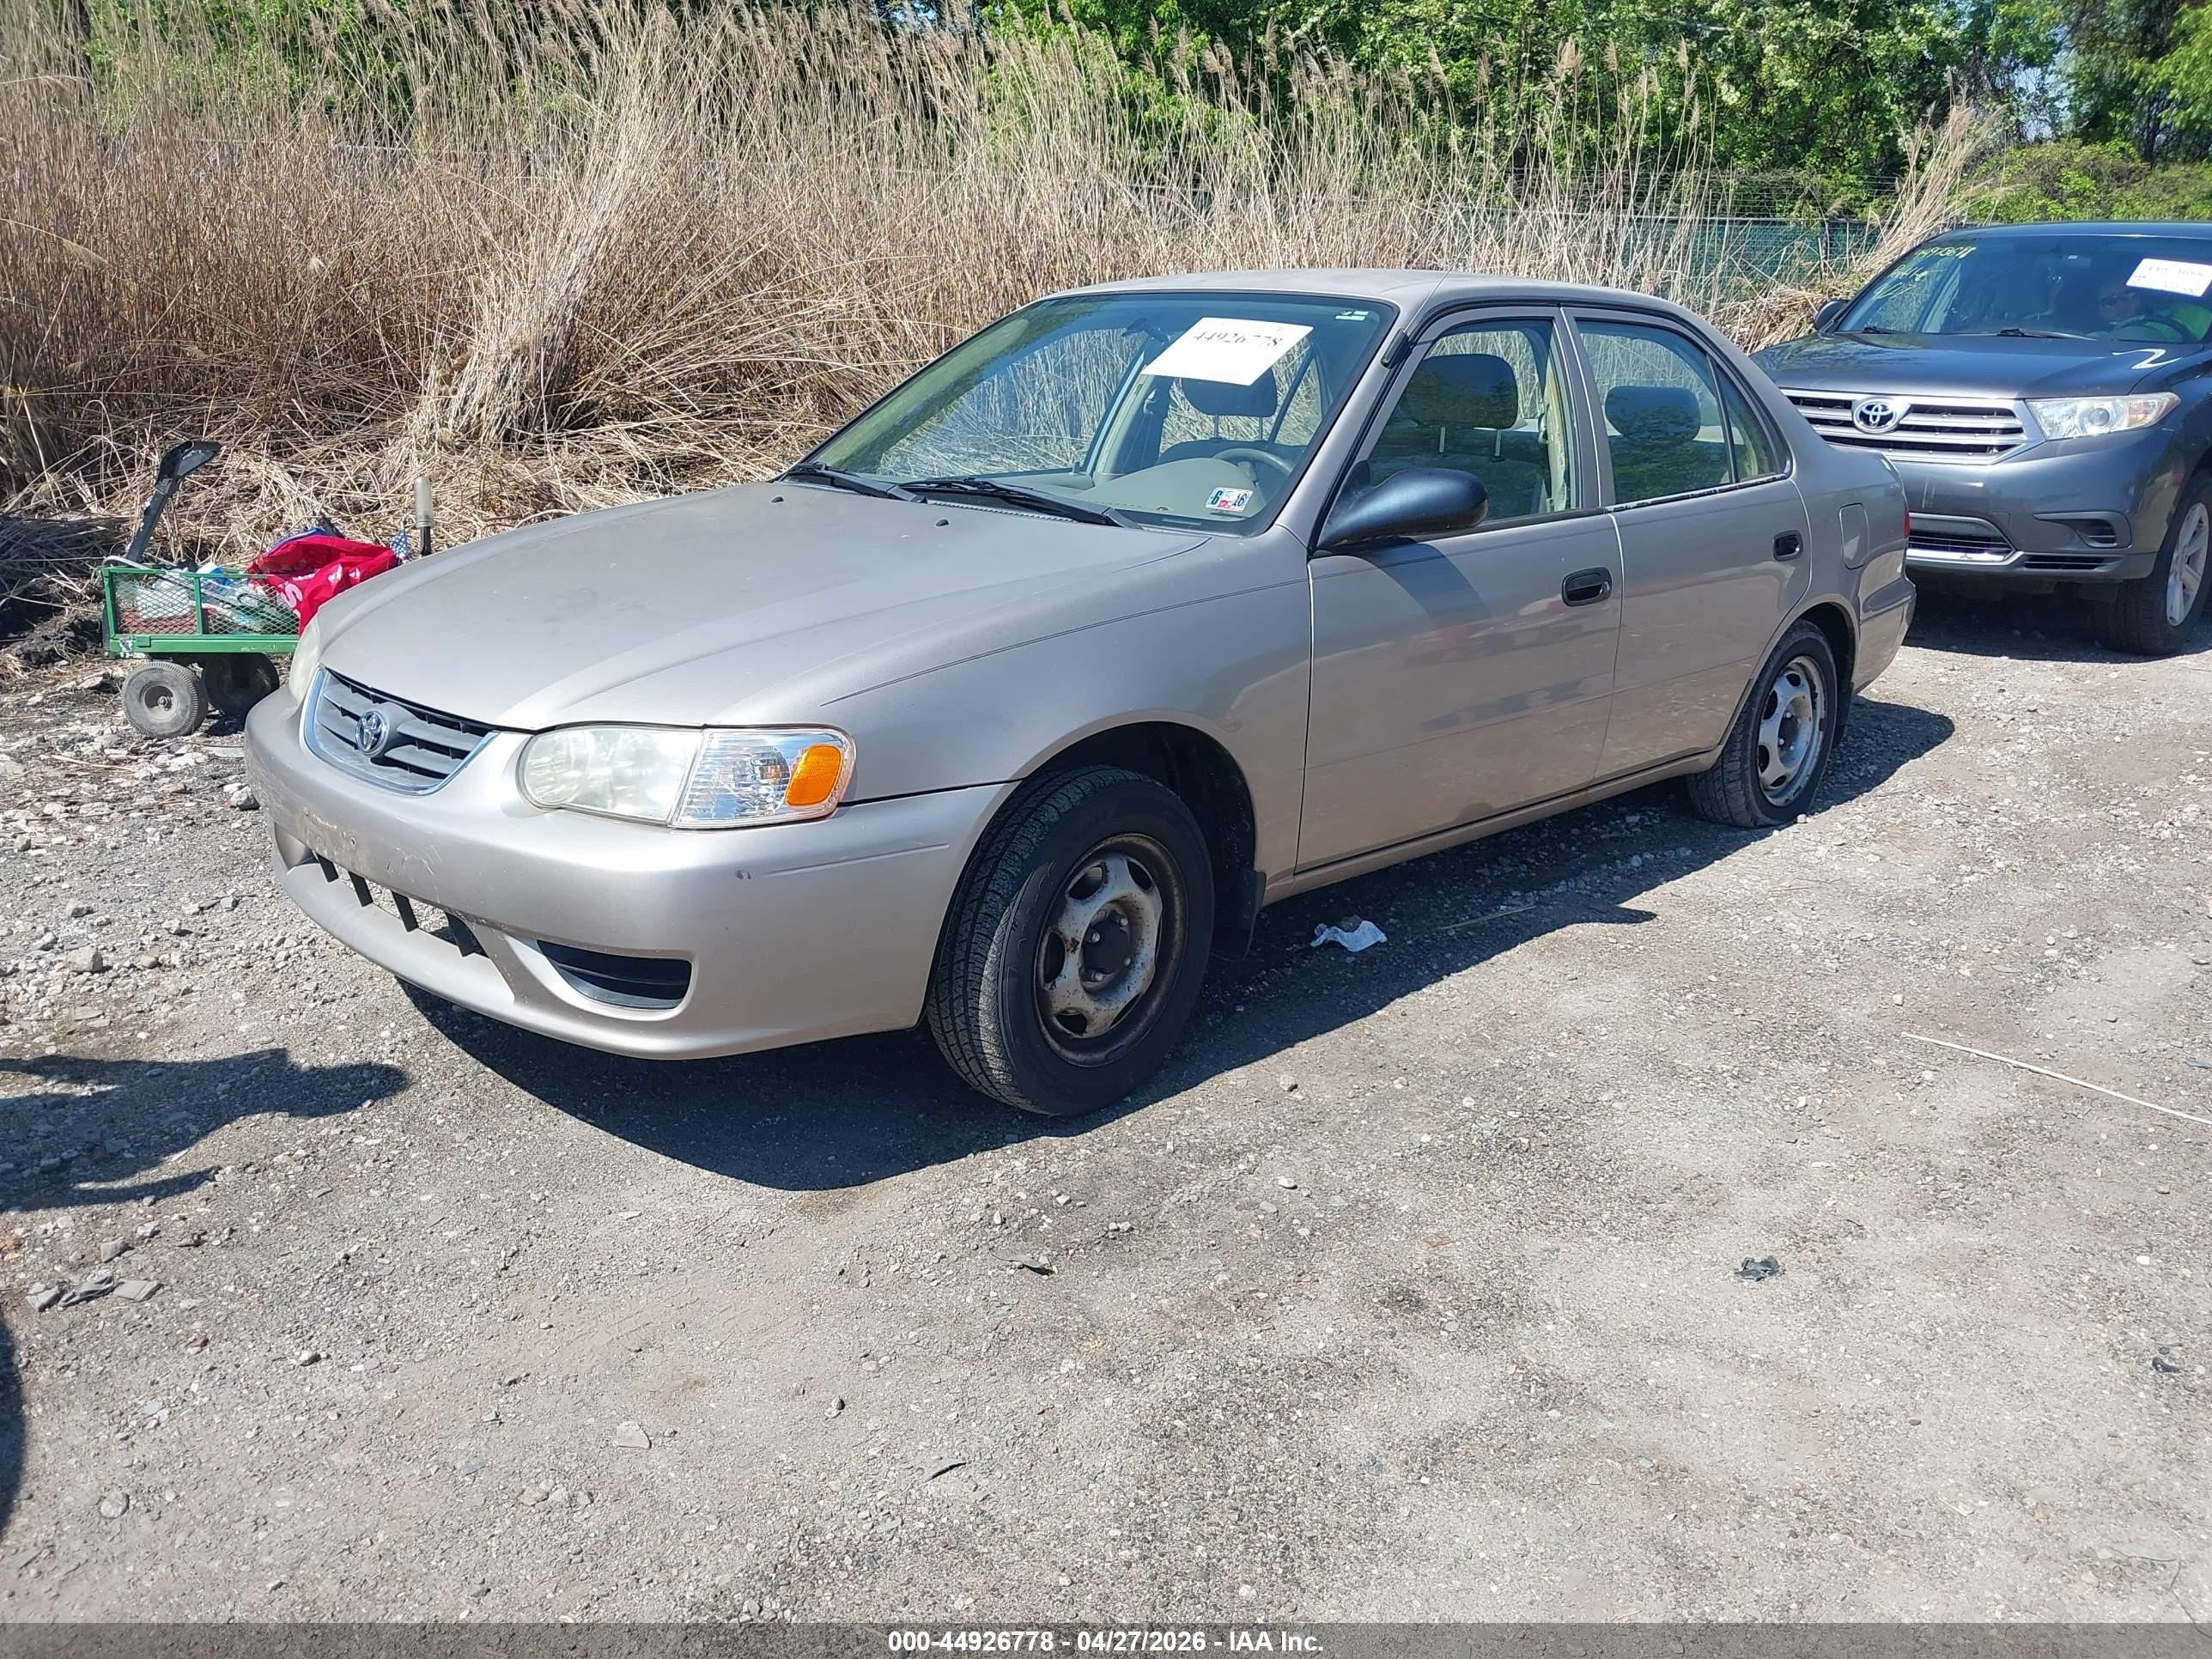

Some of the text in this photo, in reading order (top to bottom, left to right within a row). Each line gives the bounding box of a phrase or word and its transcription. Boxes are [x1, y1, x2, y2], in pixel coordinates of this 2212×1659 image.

[1193, 330, 1284, 348] 44926778
[1211, 489, 1224, 506] 6
[1231, 492, 1248, 507] 16
